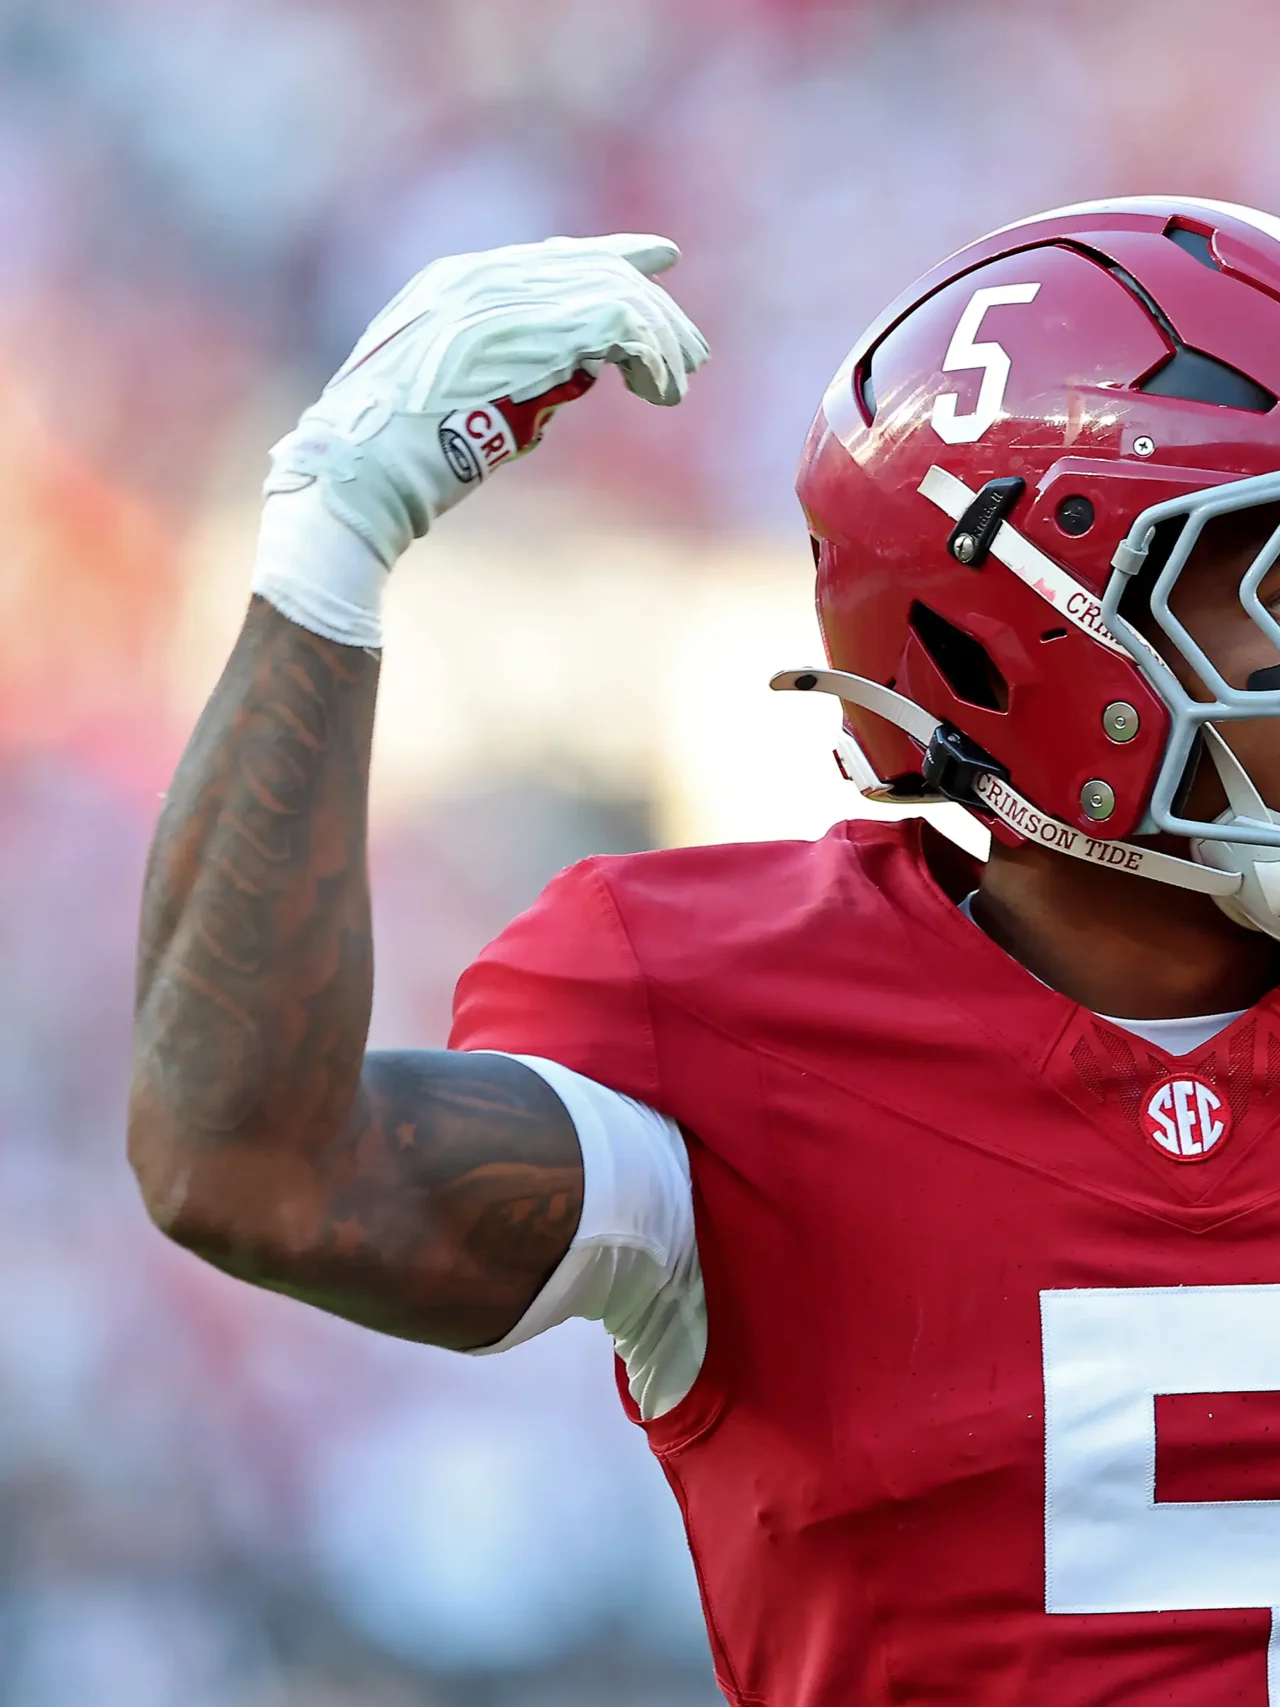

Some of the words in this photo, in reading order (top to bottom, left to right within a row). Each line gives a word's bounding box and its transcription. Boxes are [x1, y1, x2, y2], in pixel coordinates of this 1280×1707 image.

[930, 281, 1043, 445] 5
[976, 772, 1079, 850] CRIMSON
[1085, 838, 1143, 871] TIDE
[1147, 1080, 1225, 1156] SEC
